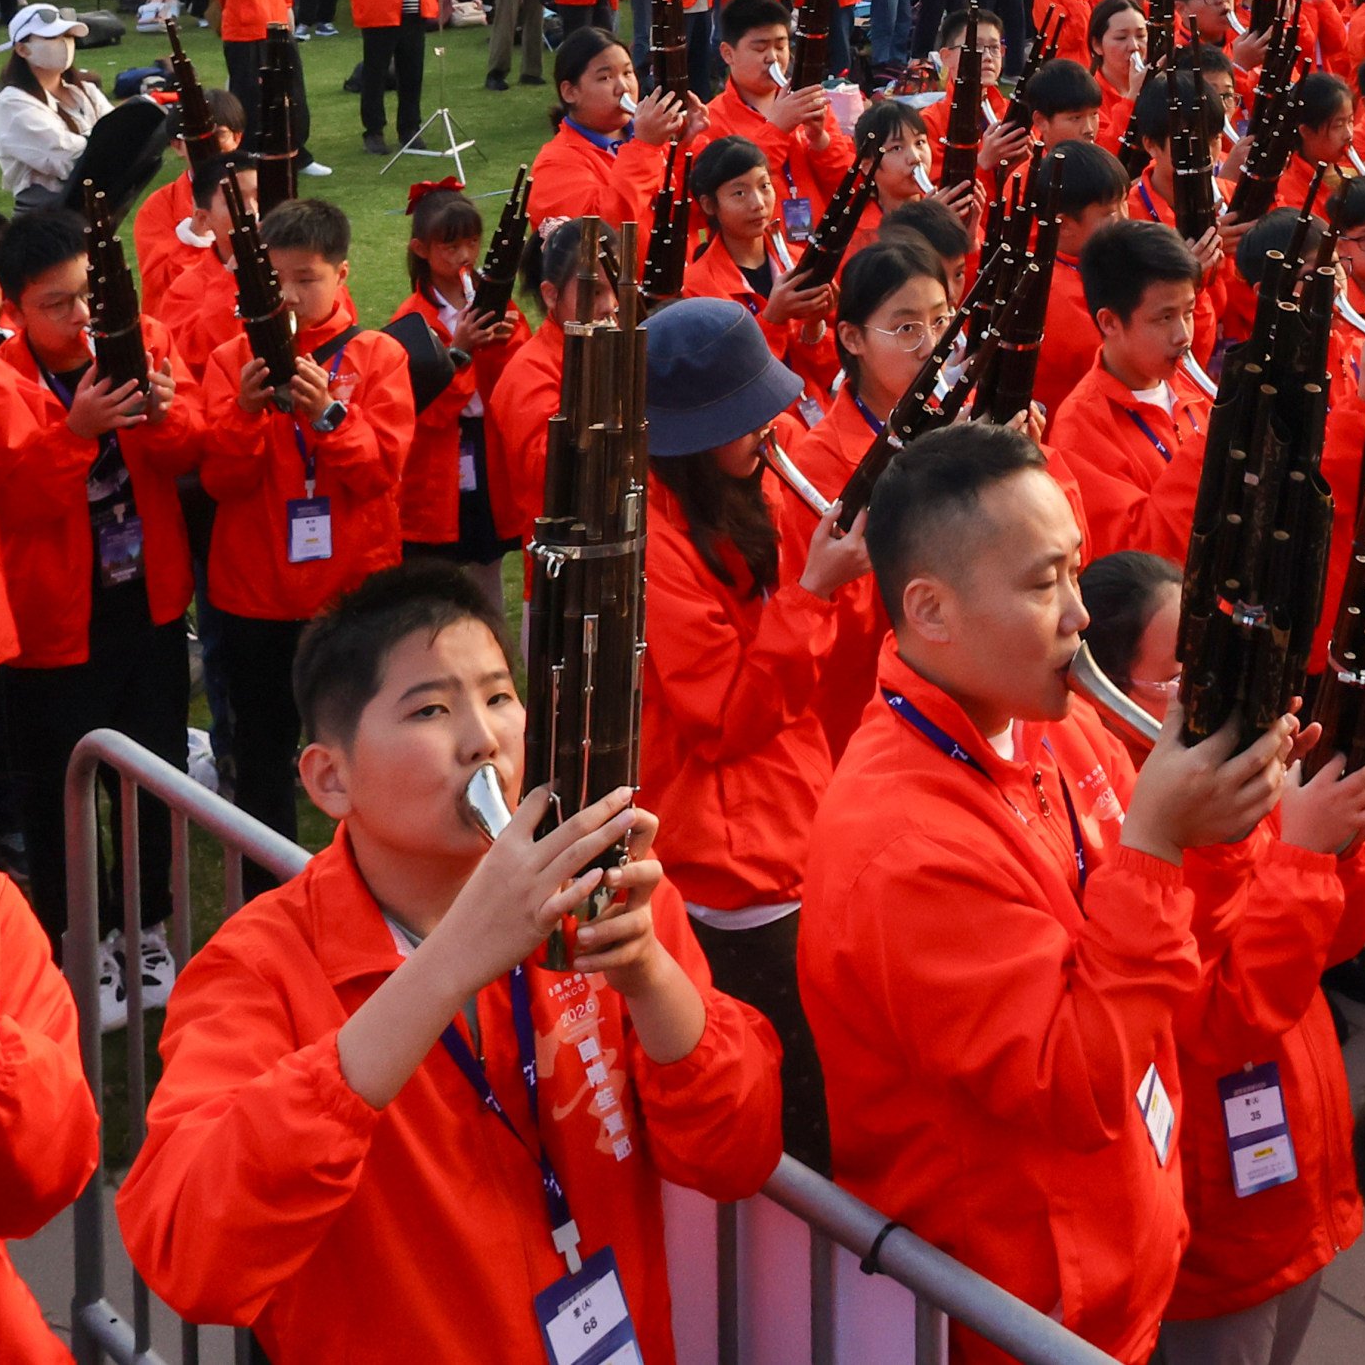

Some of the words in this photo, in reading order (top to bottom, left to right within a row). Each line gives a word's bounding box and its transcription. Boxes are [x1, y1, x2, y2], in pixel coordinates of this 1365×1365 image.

[557, 983, 586, 1003] HKCO
[559, 998, 596, 1028] 2026
[583, 1316, 598, 1335] 68
